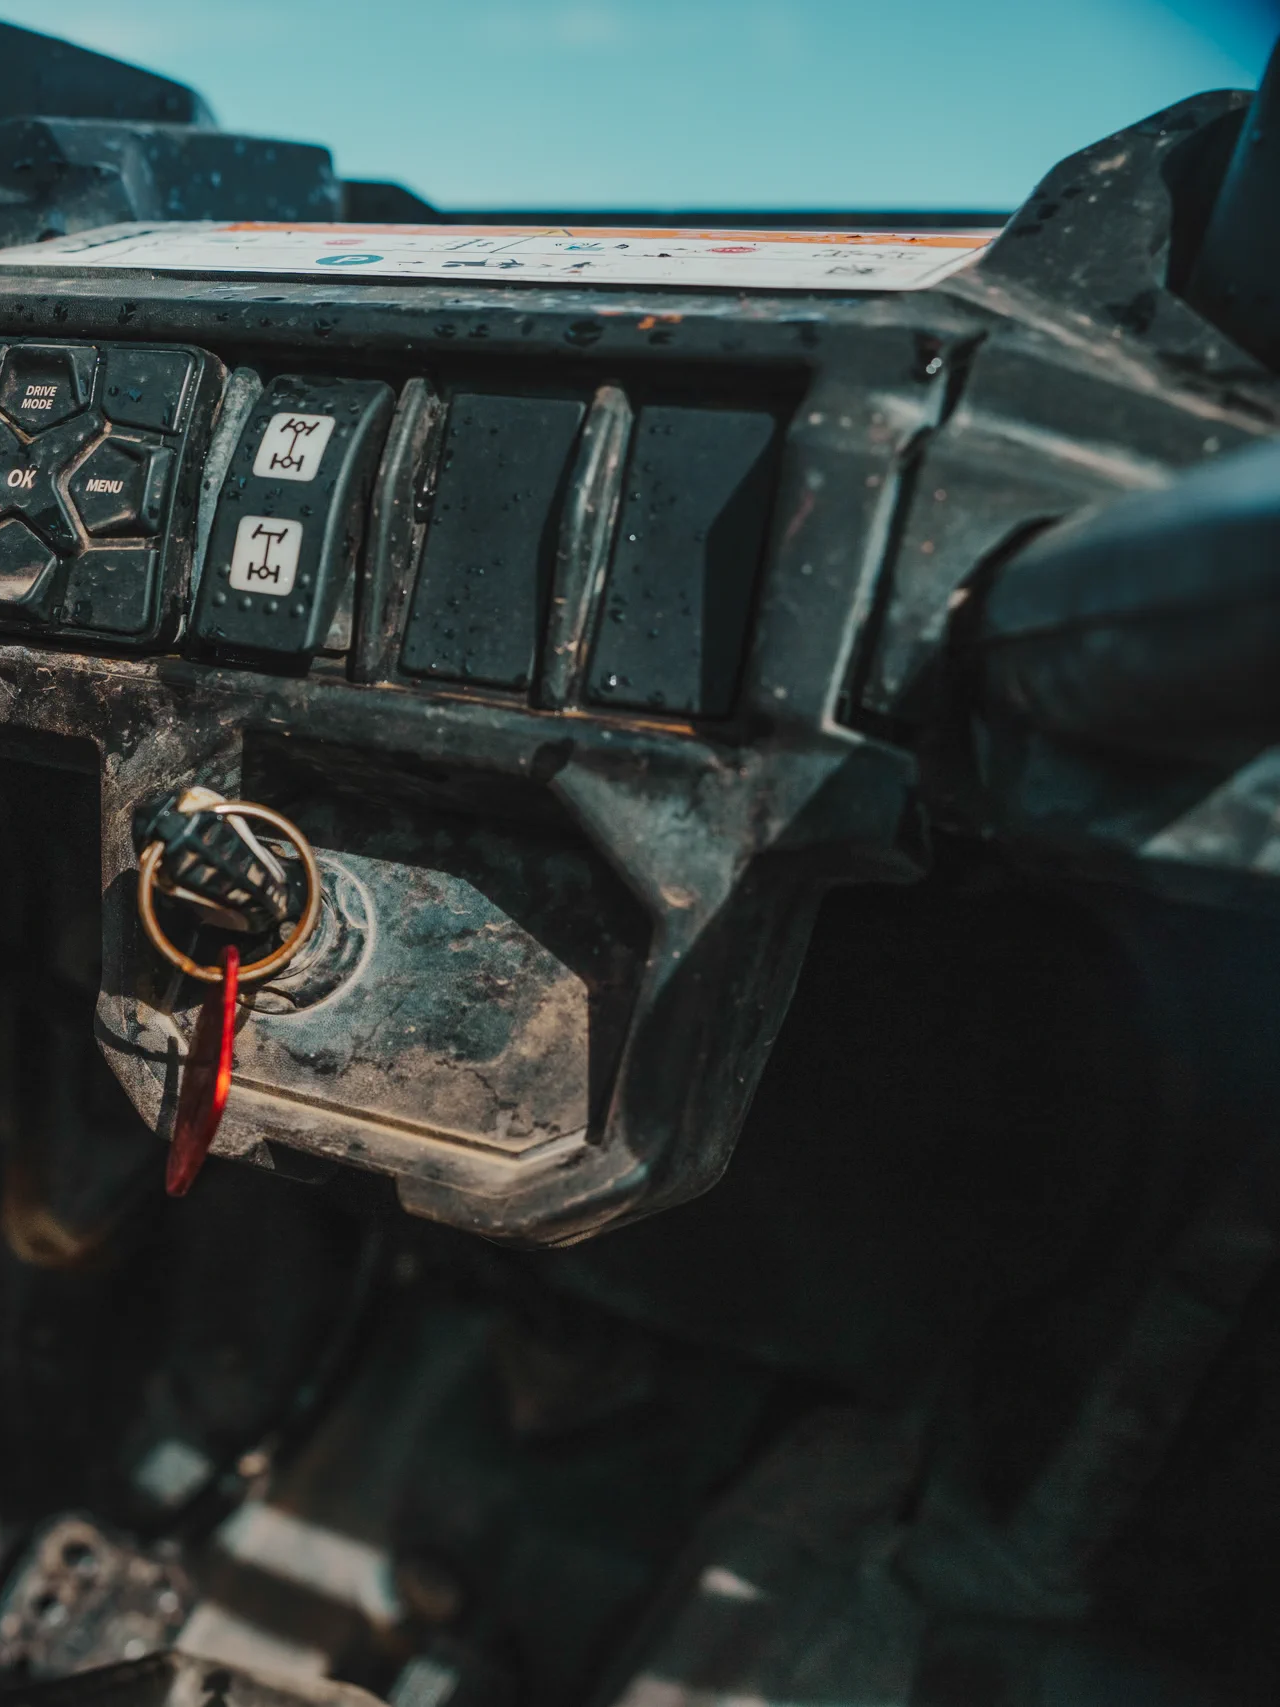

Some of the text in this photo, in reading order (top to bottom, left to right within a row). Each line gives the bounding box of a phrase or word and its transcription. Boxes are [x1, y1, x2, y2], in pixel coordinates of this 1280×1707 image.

[25, 385, 57, 397] DRIVE
[21, 398, 53, 409] MODE
[6, 469, 36, 488] OK
[86, 478, 124, 494] MENU
